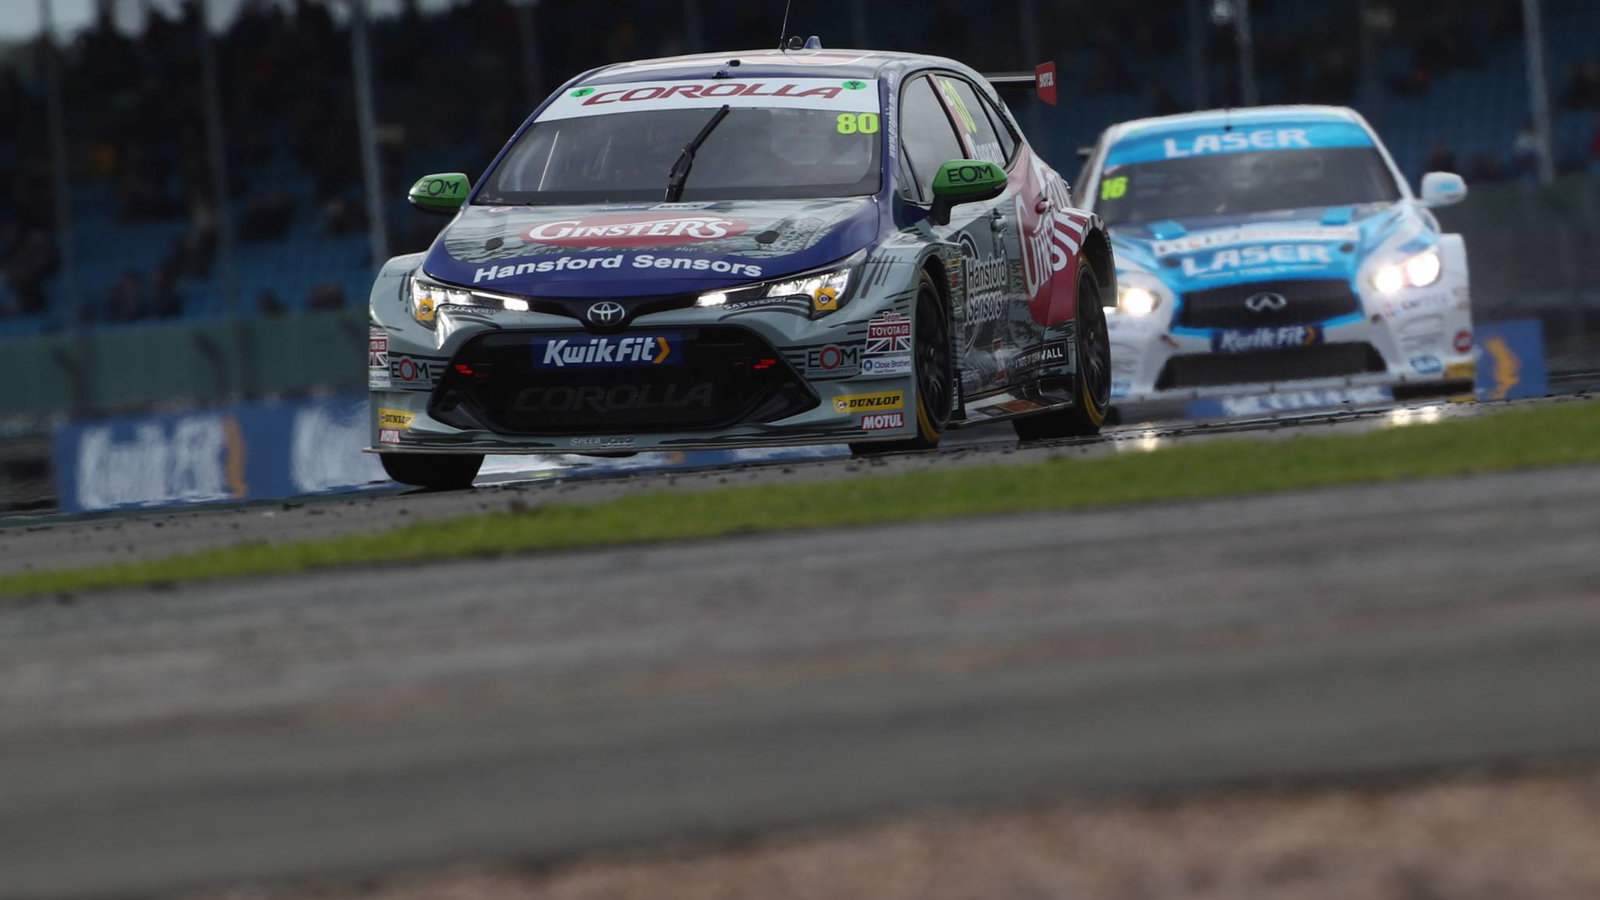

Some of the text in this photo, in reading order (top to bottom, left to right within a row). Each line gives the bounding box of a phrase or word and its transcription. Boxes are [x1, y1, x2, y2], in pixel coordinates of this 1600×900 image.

[581, 83, 845, 106] COROLLA
[837, 113, 878, 134] 80
[1164, 129, 1311, 159] LASER
[947, 165, 994, 182] EOM
[419, 179, 460, 196] EOM
[1101, 176, 1128, 200] 16
[529, 217, 734, 240] GINSTERS
[473, 254, 762, 284] Hansford Sensors
[966, 251, 1006, 291] Hansford
[1182, 245, 1331, 277] LASER
[966, 291, 1003, 325] Sensors
[871, 326, 900, 337] TOYOTA
[391, 357, 430, 382] EOM
[808, 346, 858, 370] EOM
[512, 382, 713, 413] COROLLA
[849, 396, 900, 408] DUNLOP
[863, 414, 903, 429] MOTUL
